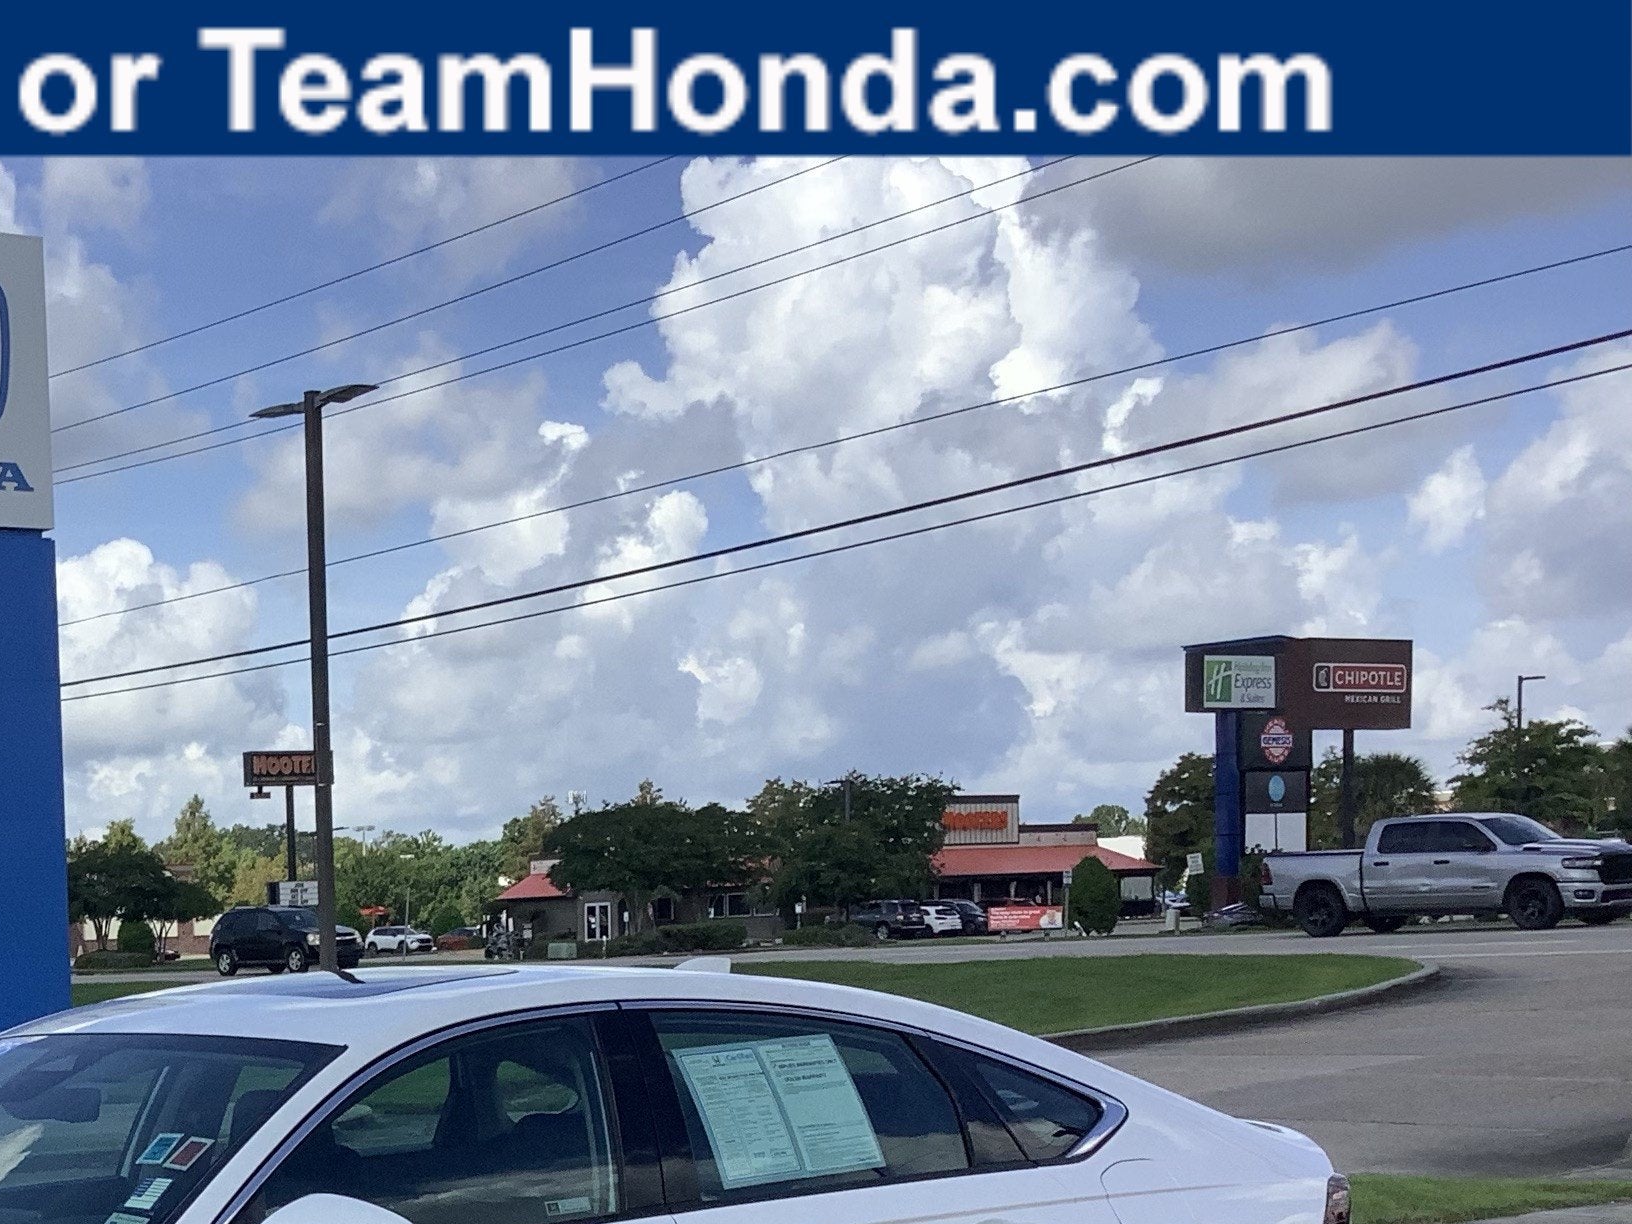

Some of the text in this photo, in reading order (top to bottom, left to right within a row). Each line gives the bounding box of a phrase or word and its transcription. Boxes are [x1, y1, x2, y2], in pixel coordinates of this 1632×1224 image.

[1234, 673, 1272, 693] Express
[1334, 670, 1403, 686] CHIPOTLE
[1344, 694, 1402, 704] MEXICAN GRILL
